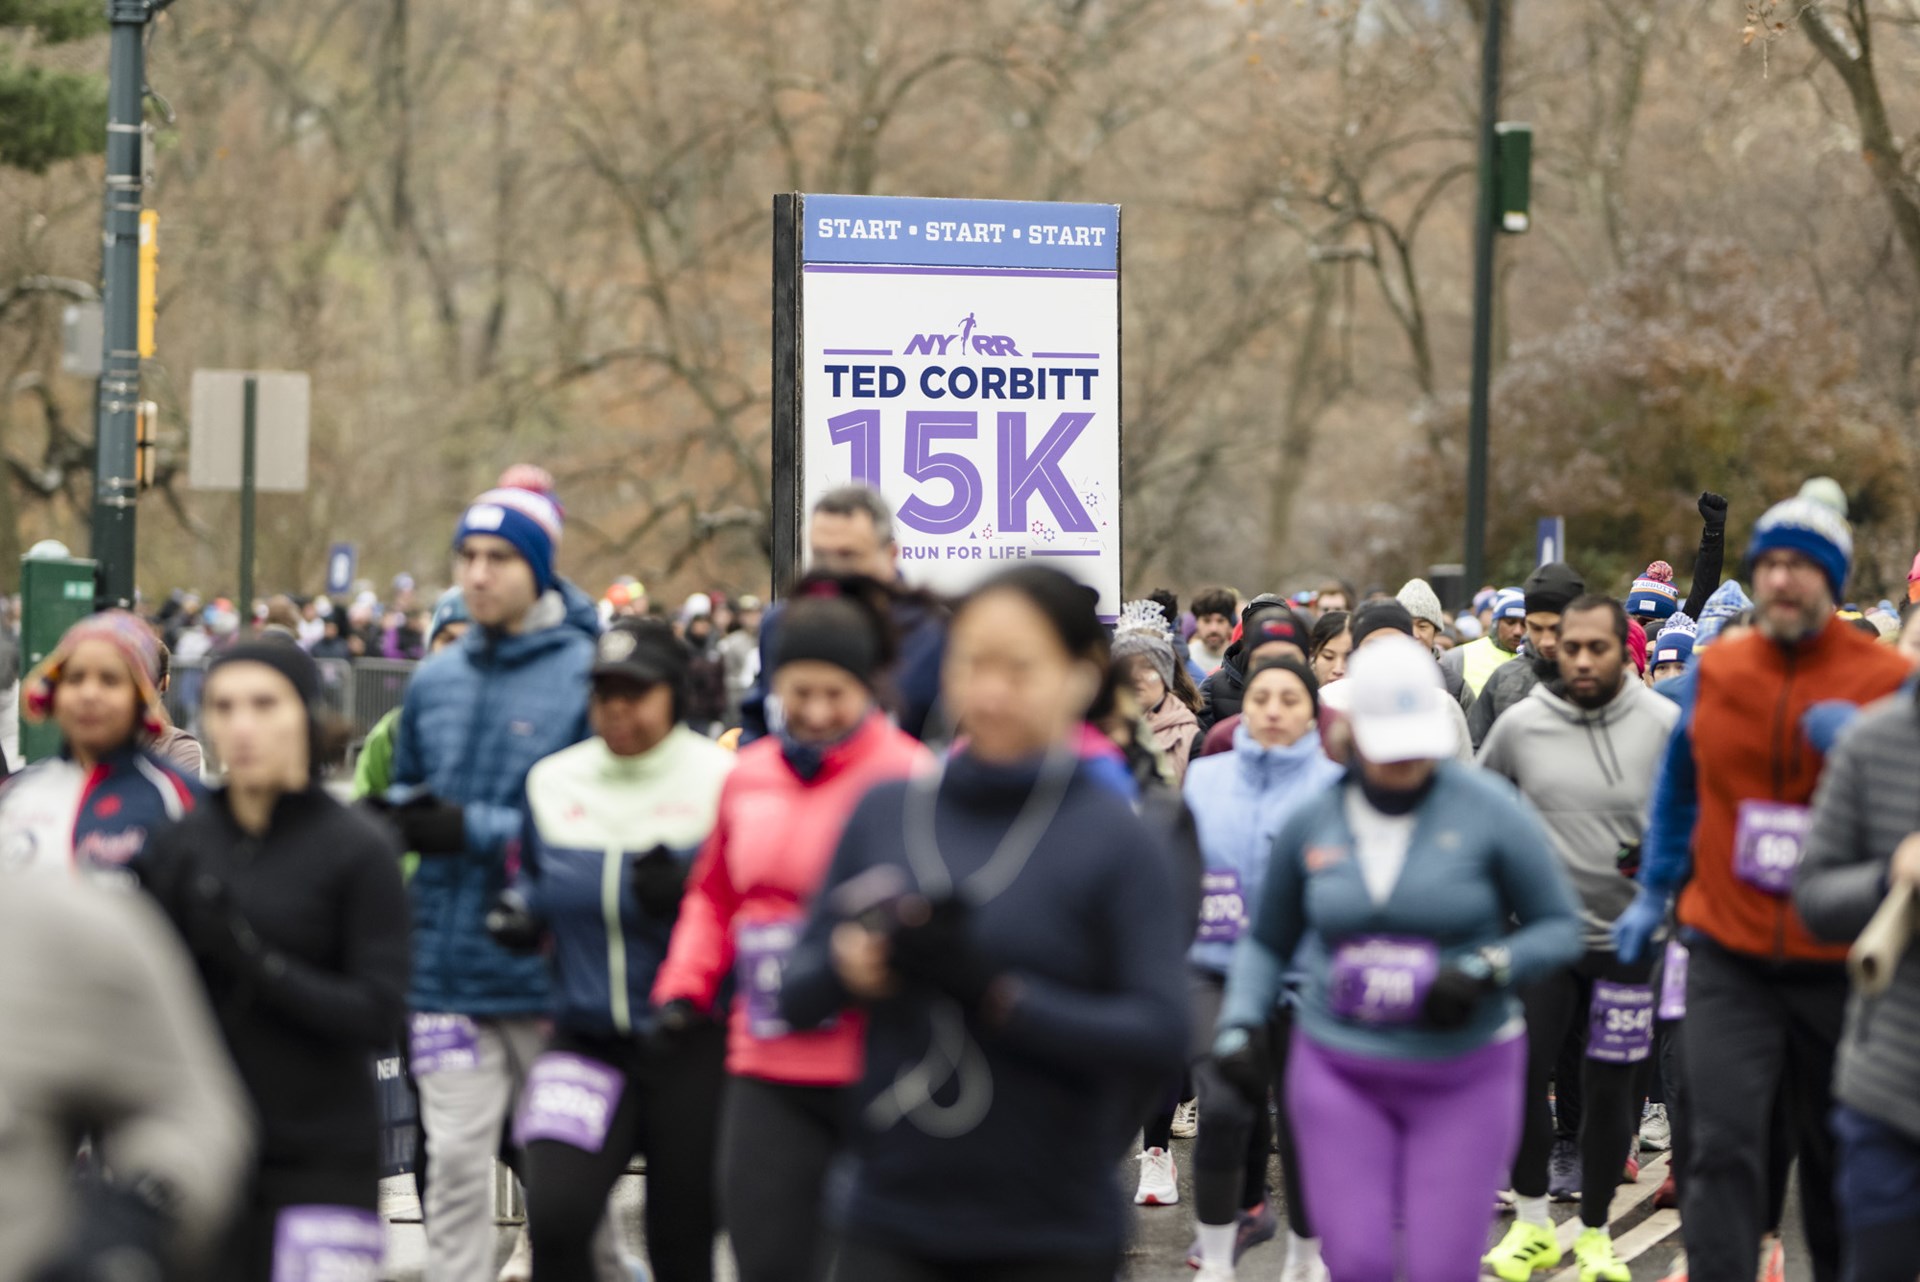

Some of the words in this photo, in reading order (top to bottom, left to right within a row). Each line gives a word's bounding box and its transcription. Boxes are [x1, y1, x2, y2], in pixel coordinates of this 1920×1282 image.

[818, 218, 901, 240] START
[925, 221, 1005, 243] START
[1028, 224, 1106, 246] START
[824, 365, 906, 398] TED
[920, 365, 1099, 400] CORBITT
[826, 408, 1099, 535] 15K
[902, 546, 940, 560] RUN
[946, 546, 982, 560] FOR
[989, 546, 1027, 560] LIFE
